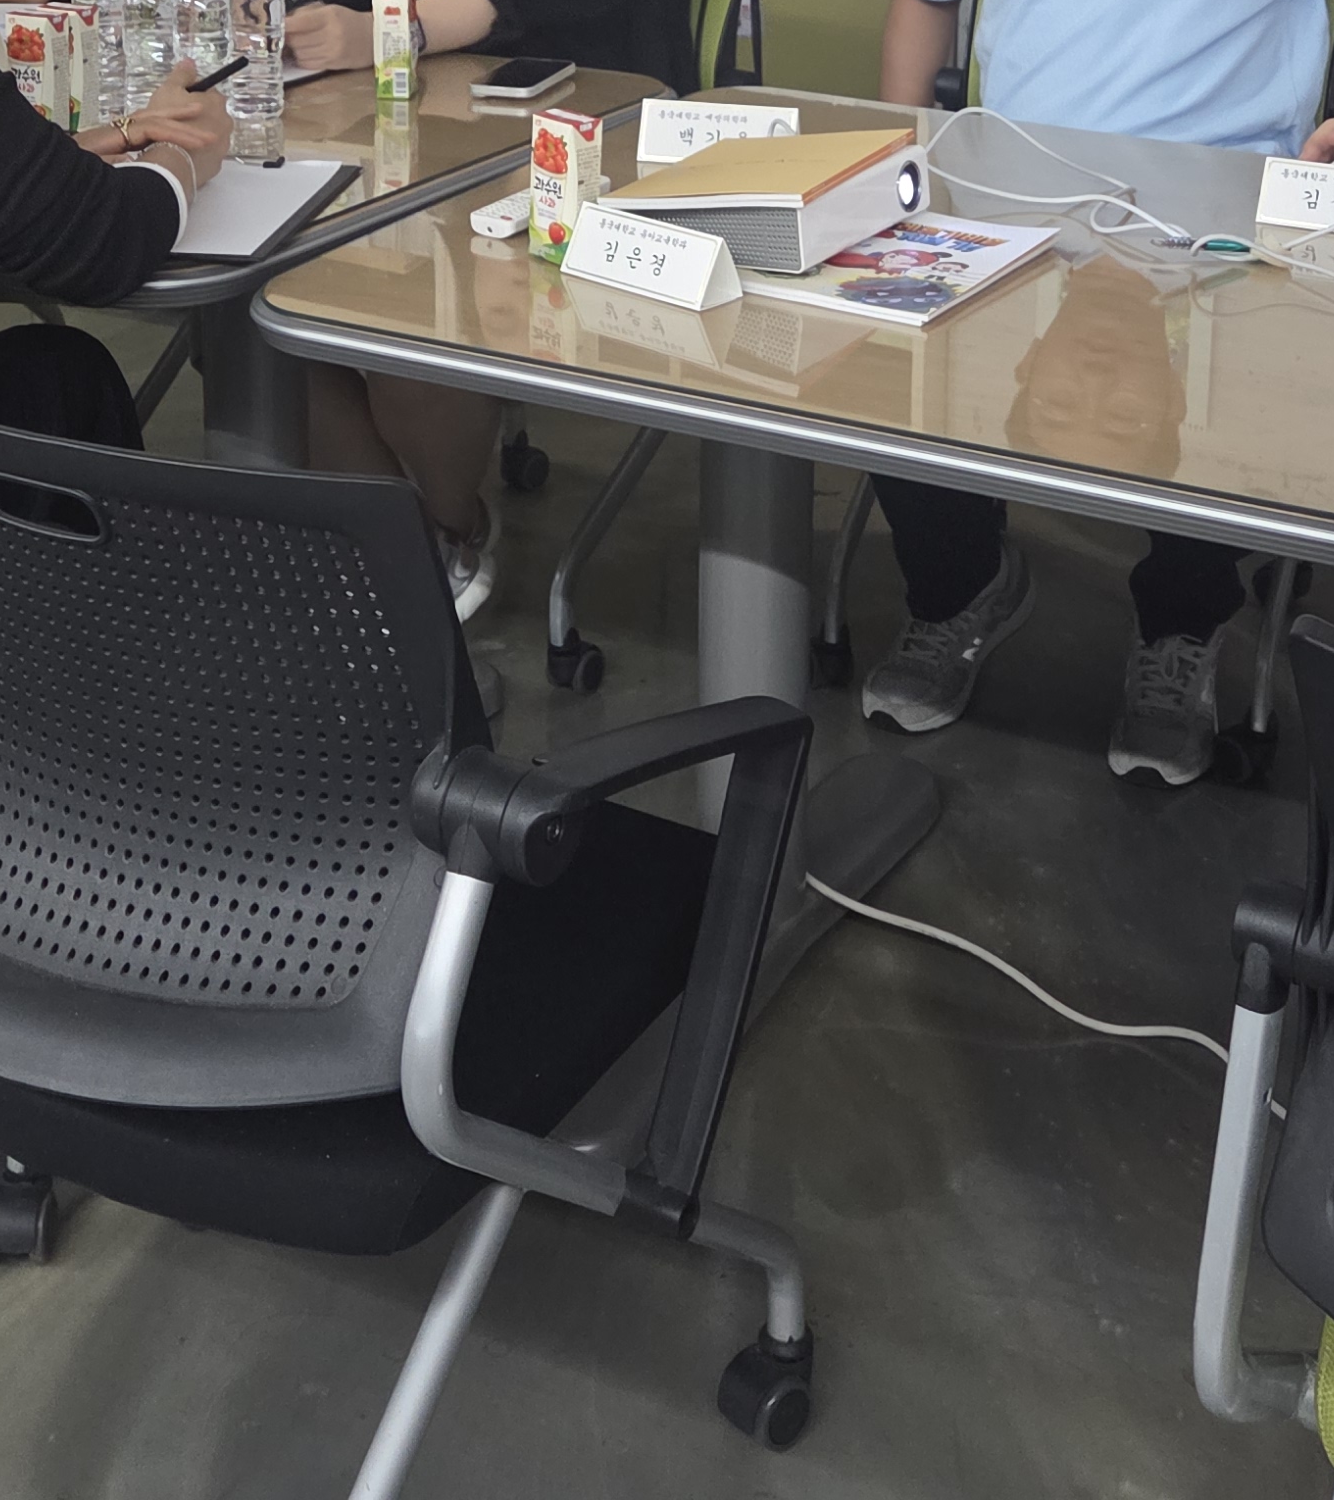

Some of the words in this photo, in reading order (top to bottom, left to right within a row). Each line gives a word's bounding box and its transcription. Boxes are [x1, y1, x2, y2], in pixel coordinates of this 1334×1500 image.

[679, 127, 694, 147] 백
[533, 175, 564, 200] 과수원
[538, 195, 556, 209] 사과
[1302, 189, 1320, 210] 김
[603, 240, 619, 263] 김
[625, 246, 643, 269] 은
[649, 253, 666, 277] 경
